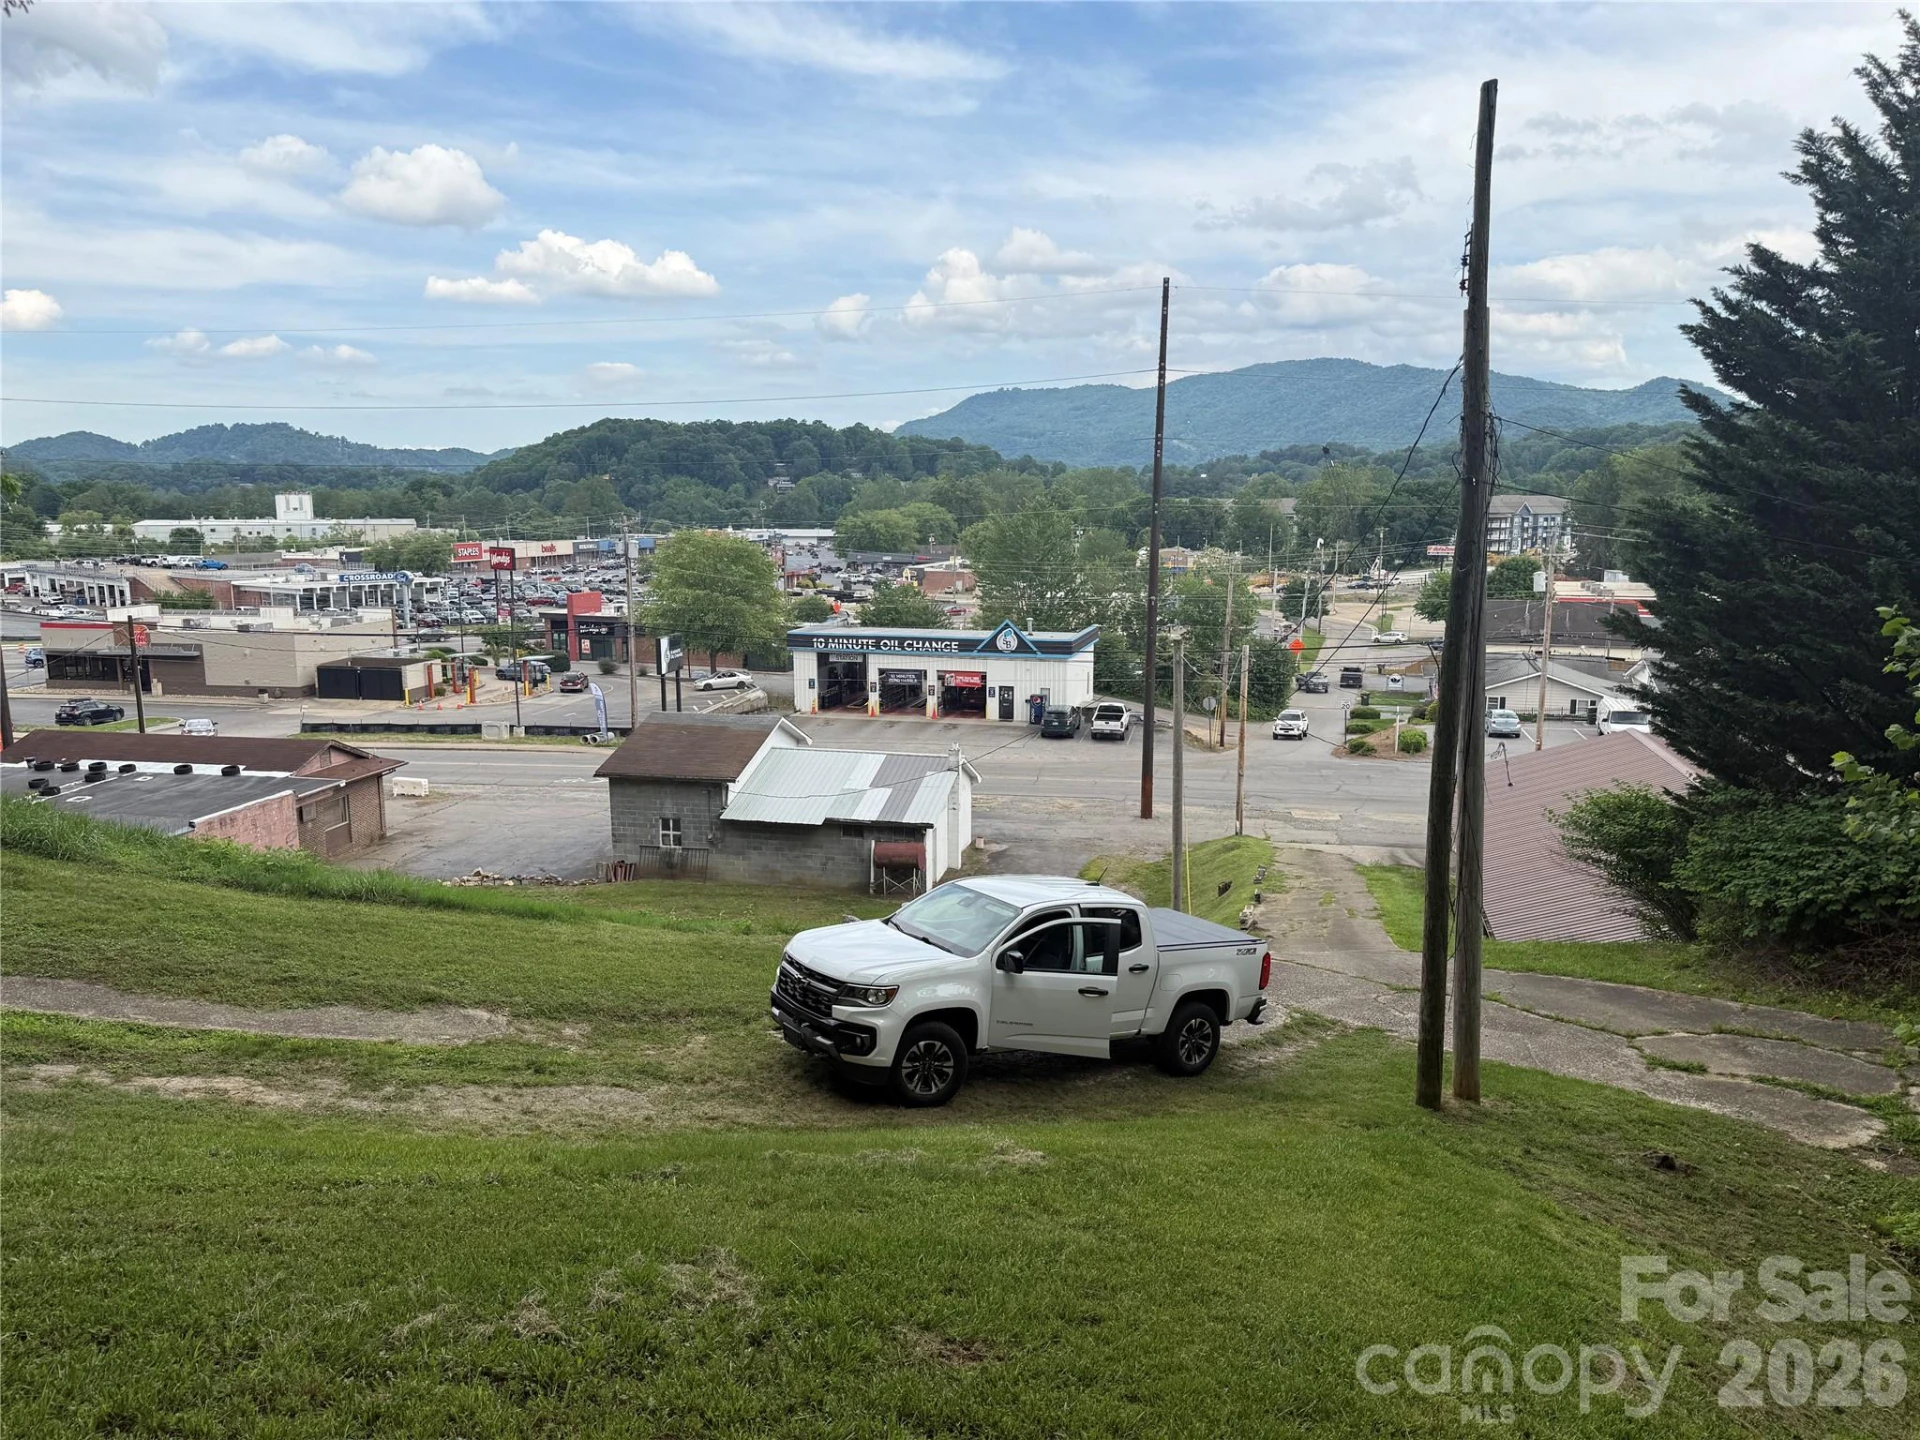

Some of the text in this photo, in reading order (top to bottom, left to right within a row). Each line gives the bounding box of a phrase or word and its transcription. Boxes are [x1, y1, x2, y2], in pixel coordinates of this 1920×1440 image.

[458, 547, 480, 557] STAPLES
[541, 542, 556, 555] bealls
[491, 552, 511, 567] Wendy's
[812, 637, 959, 653] 10 MINUTE OIL CHANGE
